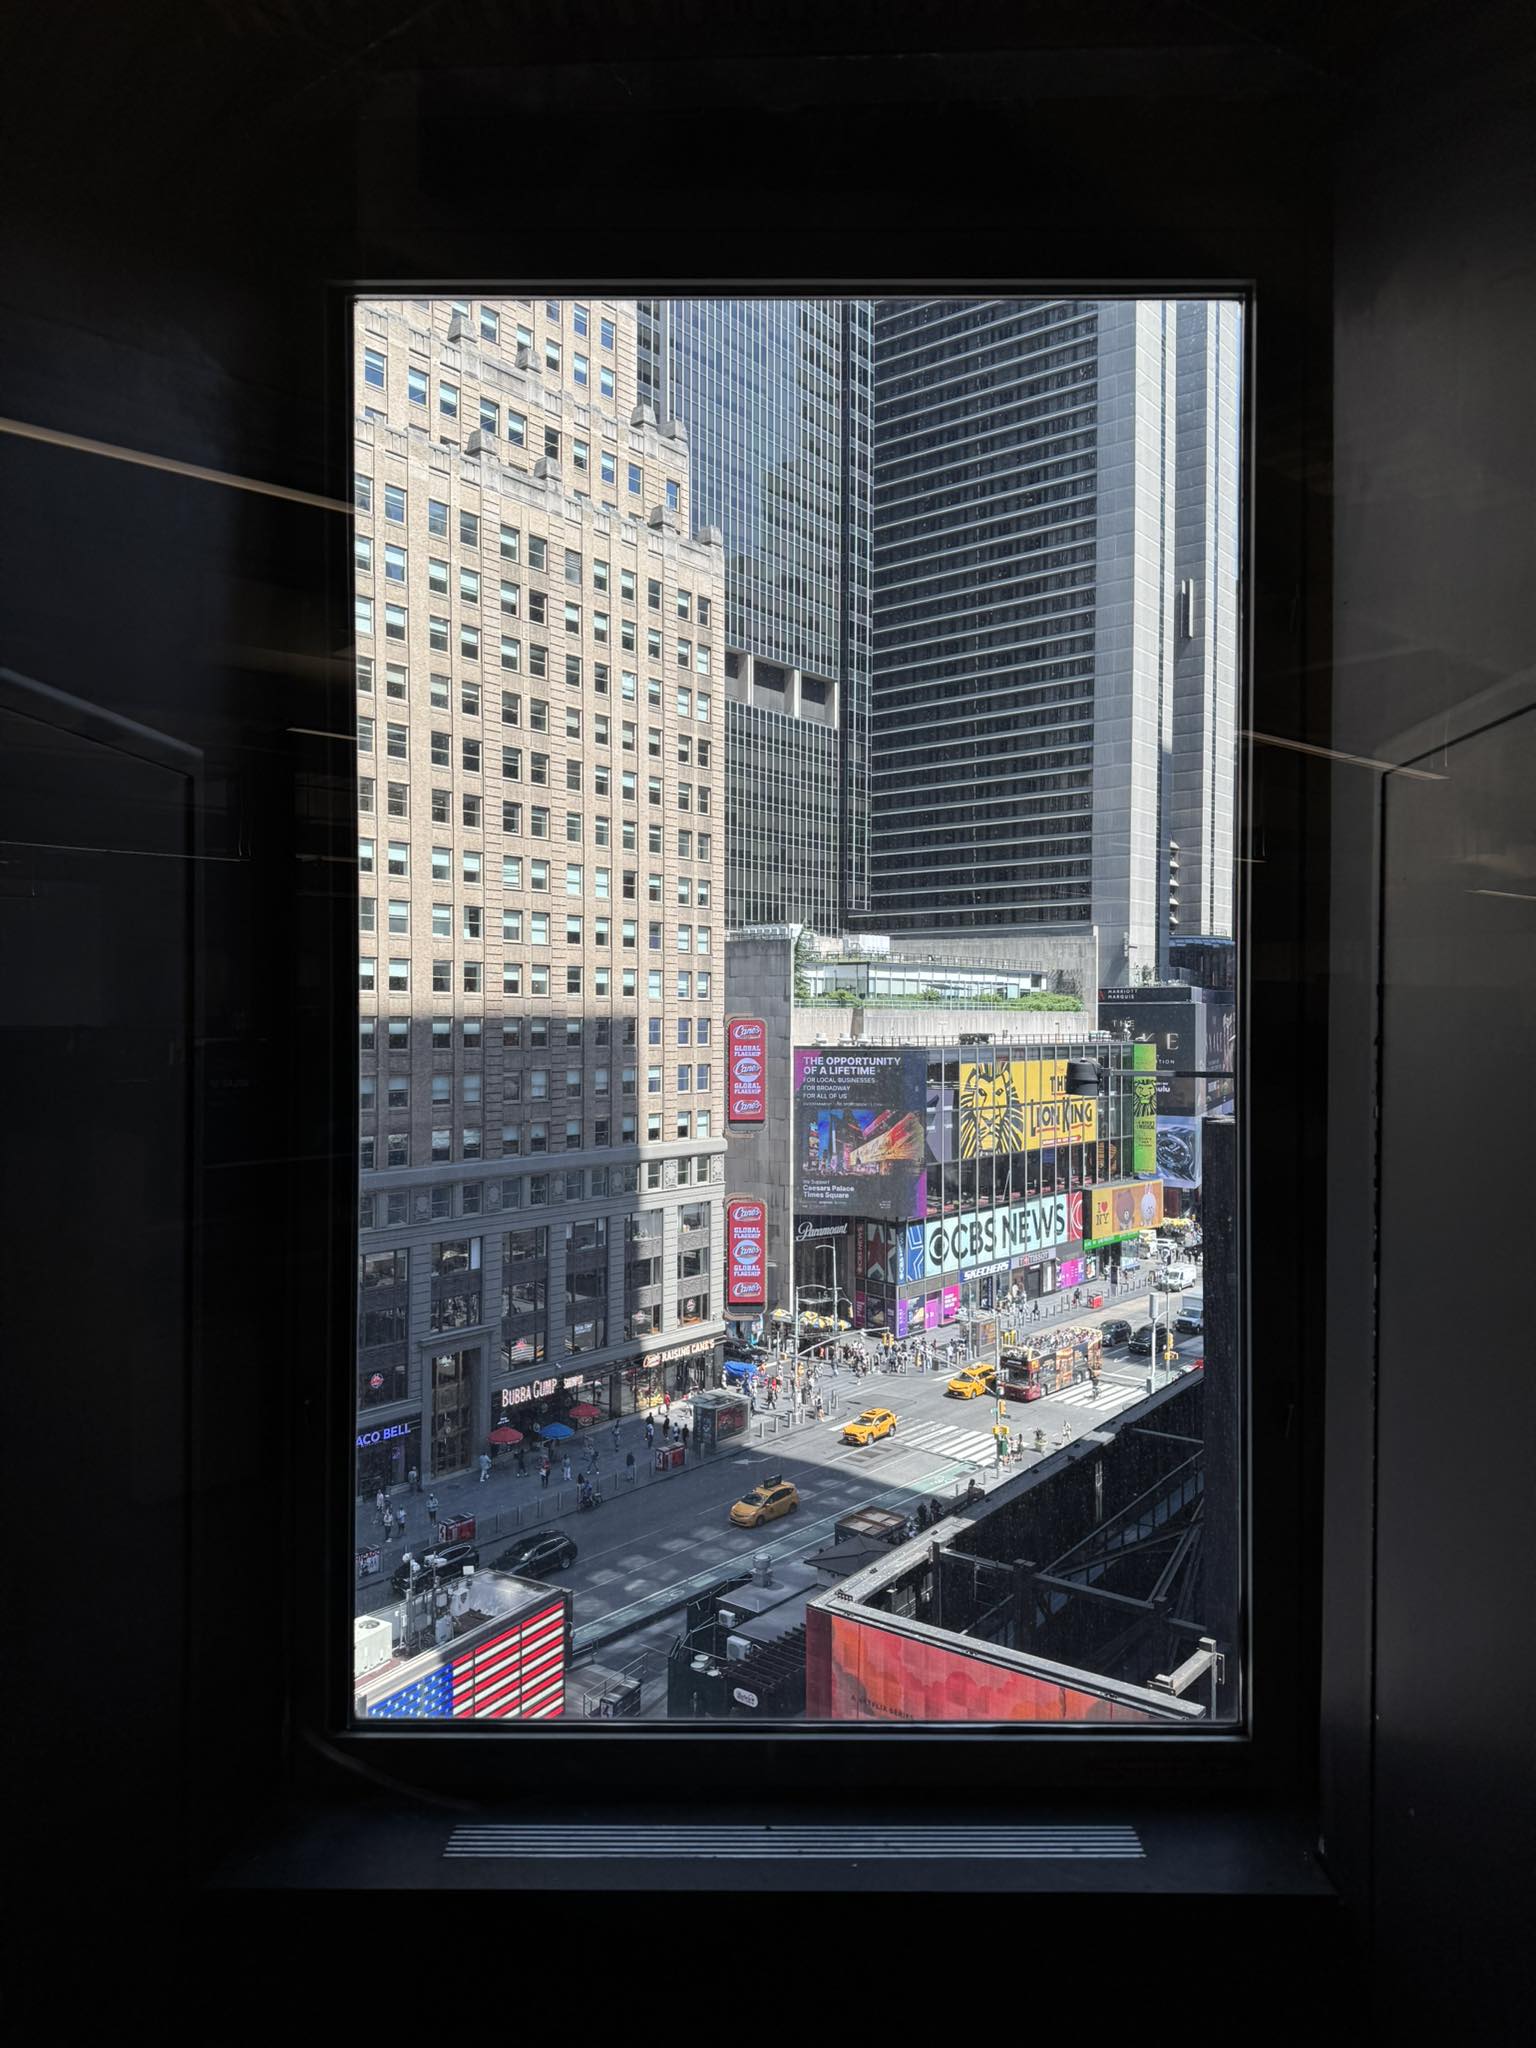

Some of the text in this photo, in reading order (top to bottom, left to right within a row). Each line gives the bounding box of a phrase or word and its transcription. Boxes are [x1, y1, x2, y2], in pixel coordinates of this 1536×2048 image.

[803, 1057, 901, 1066] THE OPPORTUNITY
[803, 1066, 876, 1075] OF A LIFETIME
[1031, 1097, 1093, 1137] LION KING
[1095, 1213, 1109, 1226] NY
[796, 1221, 848, 1241] Paramount
[951, 1204, 1065, 1260] CBS NEWS
[964, 1260, 1009, 1281] SKECHERS
[662, 1344, 691, 1361] RAISING
[502, 1385, 532, 1407] BUBBA
[533, 1378, 558, 1398] GUMP
[383, 1423, 411, 1440] BELL
